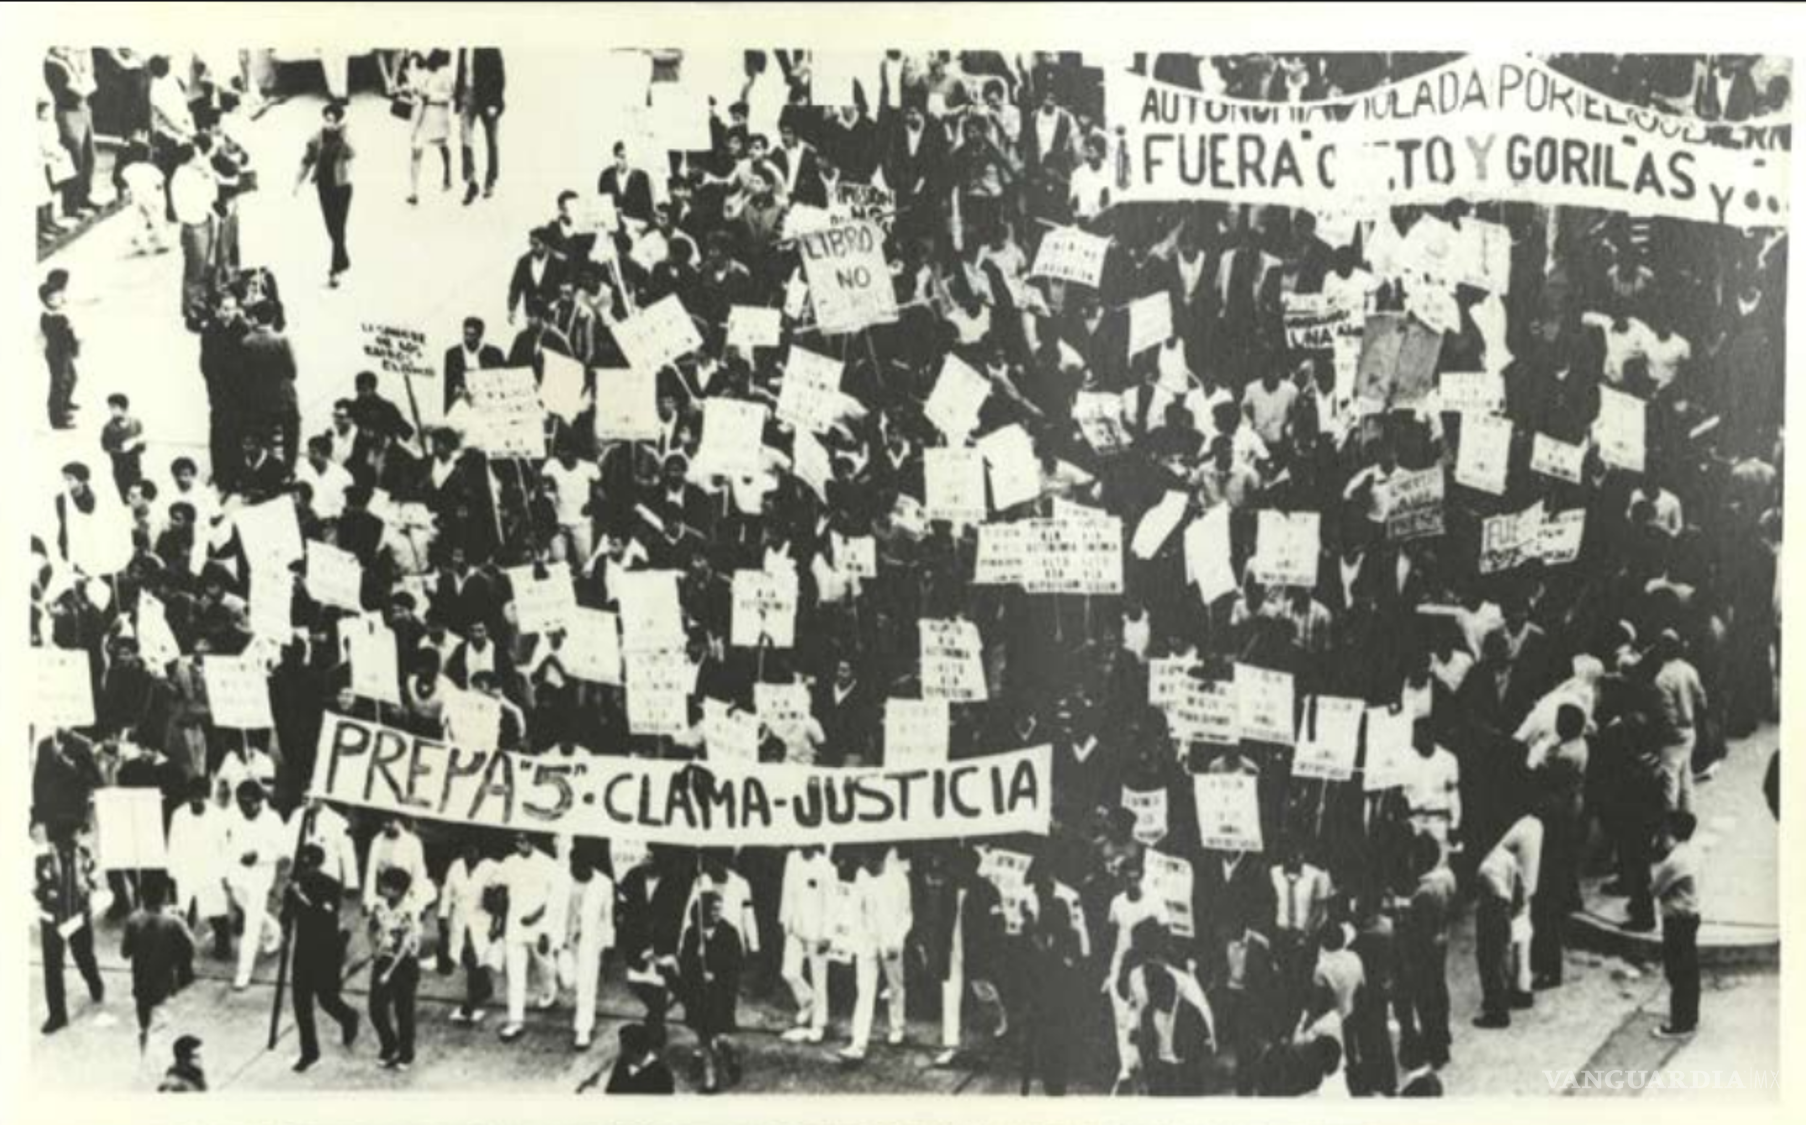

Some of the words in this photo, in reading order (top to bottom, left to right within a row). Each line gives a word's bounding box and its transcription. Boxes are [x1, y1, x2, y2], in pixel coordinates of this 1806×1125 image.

[1465, 133, 1497, 182] Y
[1506, 134, 1697, 202] GORILAS
[835, 265, 872, 289] NO
[325, 719, 515, 824] PREPA
